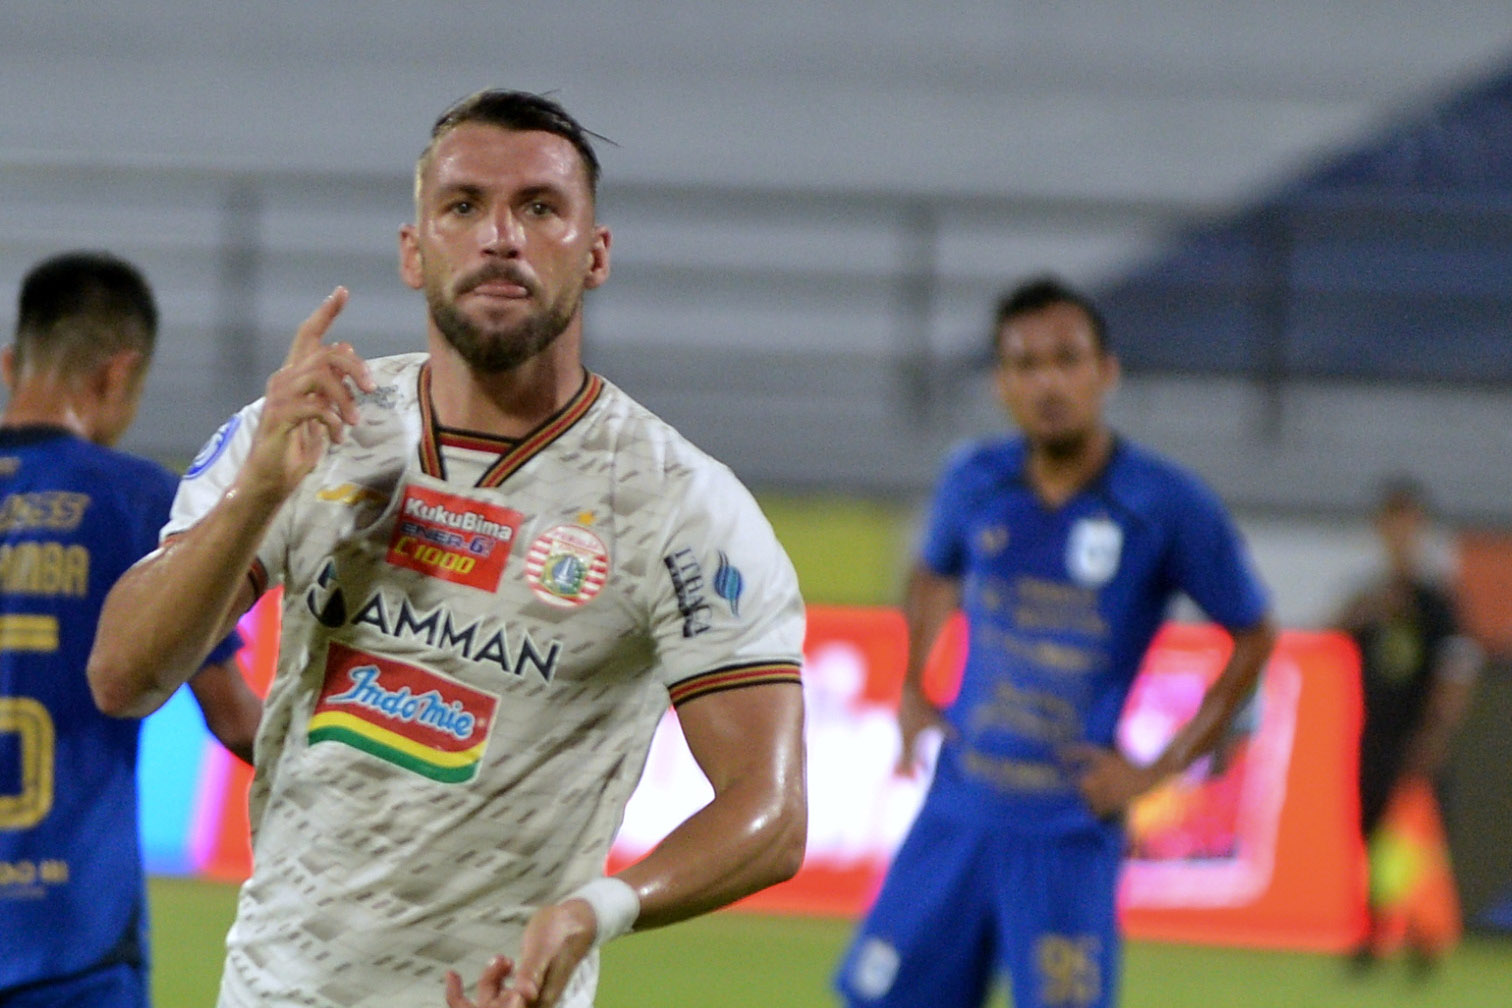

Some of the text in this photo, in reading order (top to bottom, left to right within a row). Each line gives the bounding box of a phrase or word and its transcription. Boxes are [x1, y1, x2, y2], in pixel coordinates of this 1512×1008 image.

[405, 498, 513, 541] KukuBima
[393, 536, 476, 574] C1000
[350, 591, 561, 683] AMMAN
[326, 665, 476, 740] Indomie
